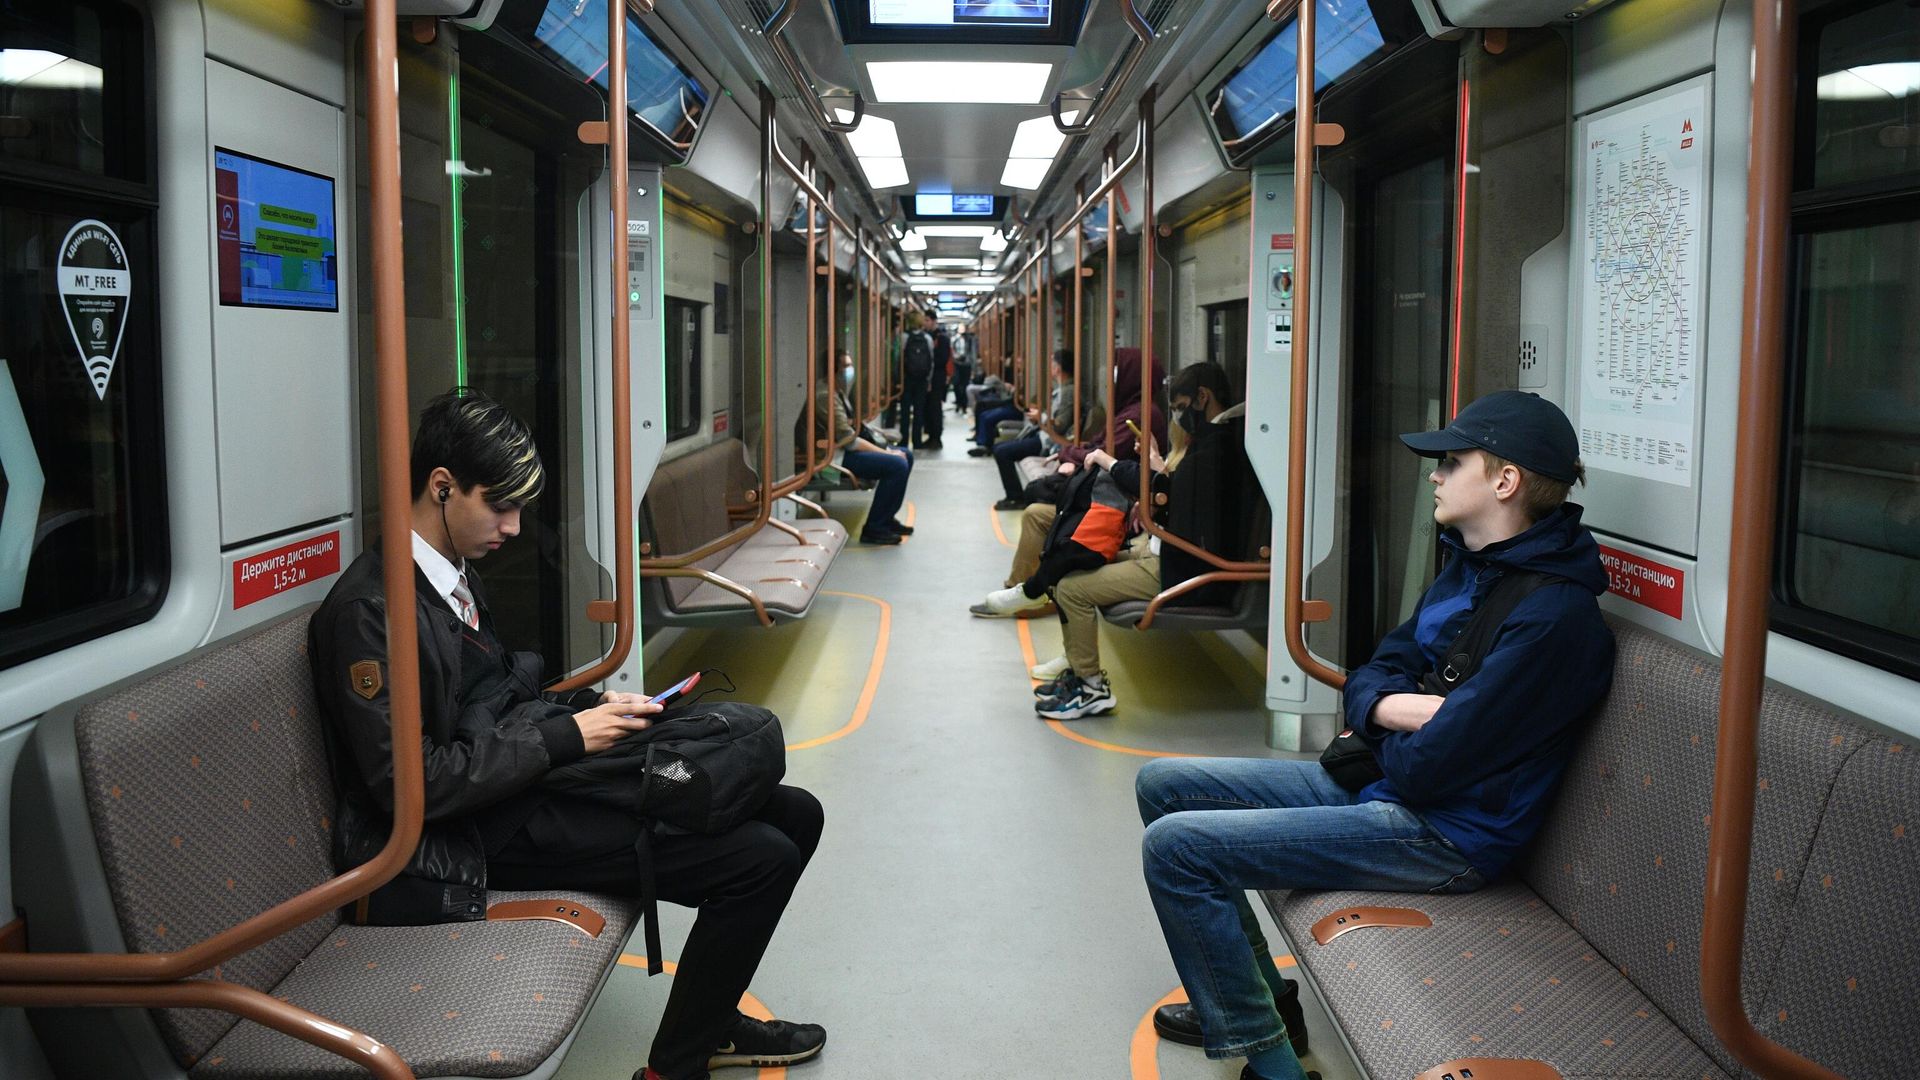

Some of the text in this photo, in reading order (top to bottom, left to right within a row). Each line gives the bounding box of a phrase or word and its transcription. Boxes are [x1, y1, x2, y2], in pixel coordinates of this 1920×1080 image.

[67, 230, 92, 260] ЕДИНАЯ
[110, 242, 121, 264] СЕТЬ
[75, 274, 117, 291] MT_FREE
[241, 540, 334, 583] Держите дистанцию
[1622, 560, 1676, 589] дистанцию
[273, 567, 307, 591] 1,5-2 м
[1608, 571, 1641, 598] 1,5-2 м
